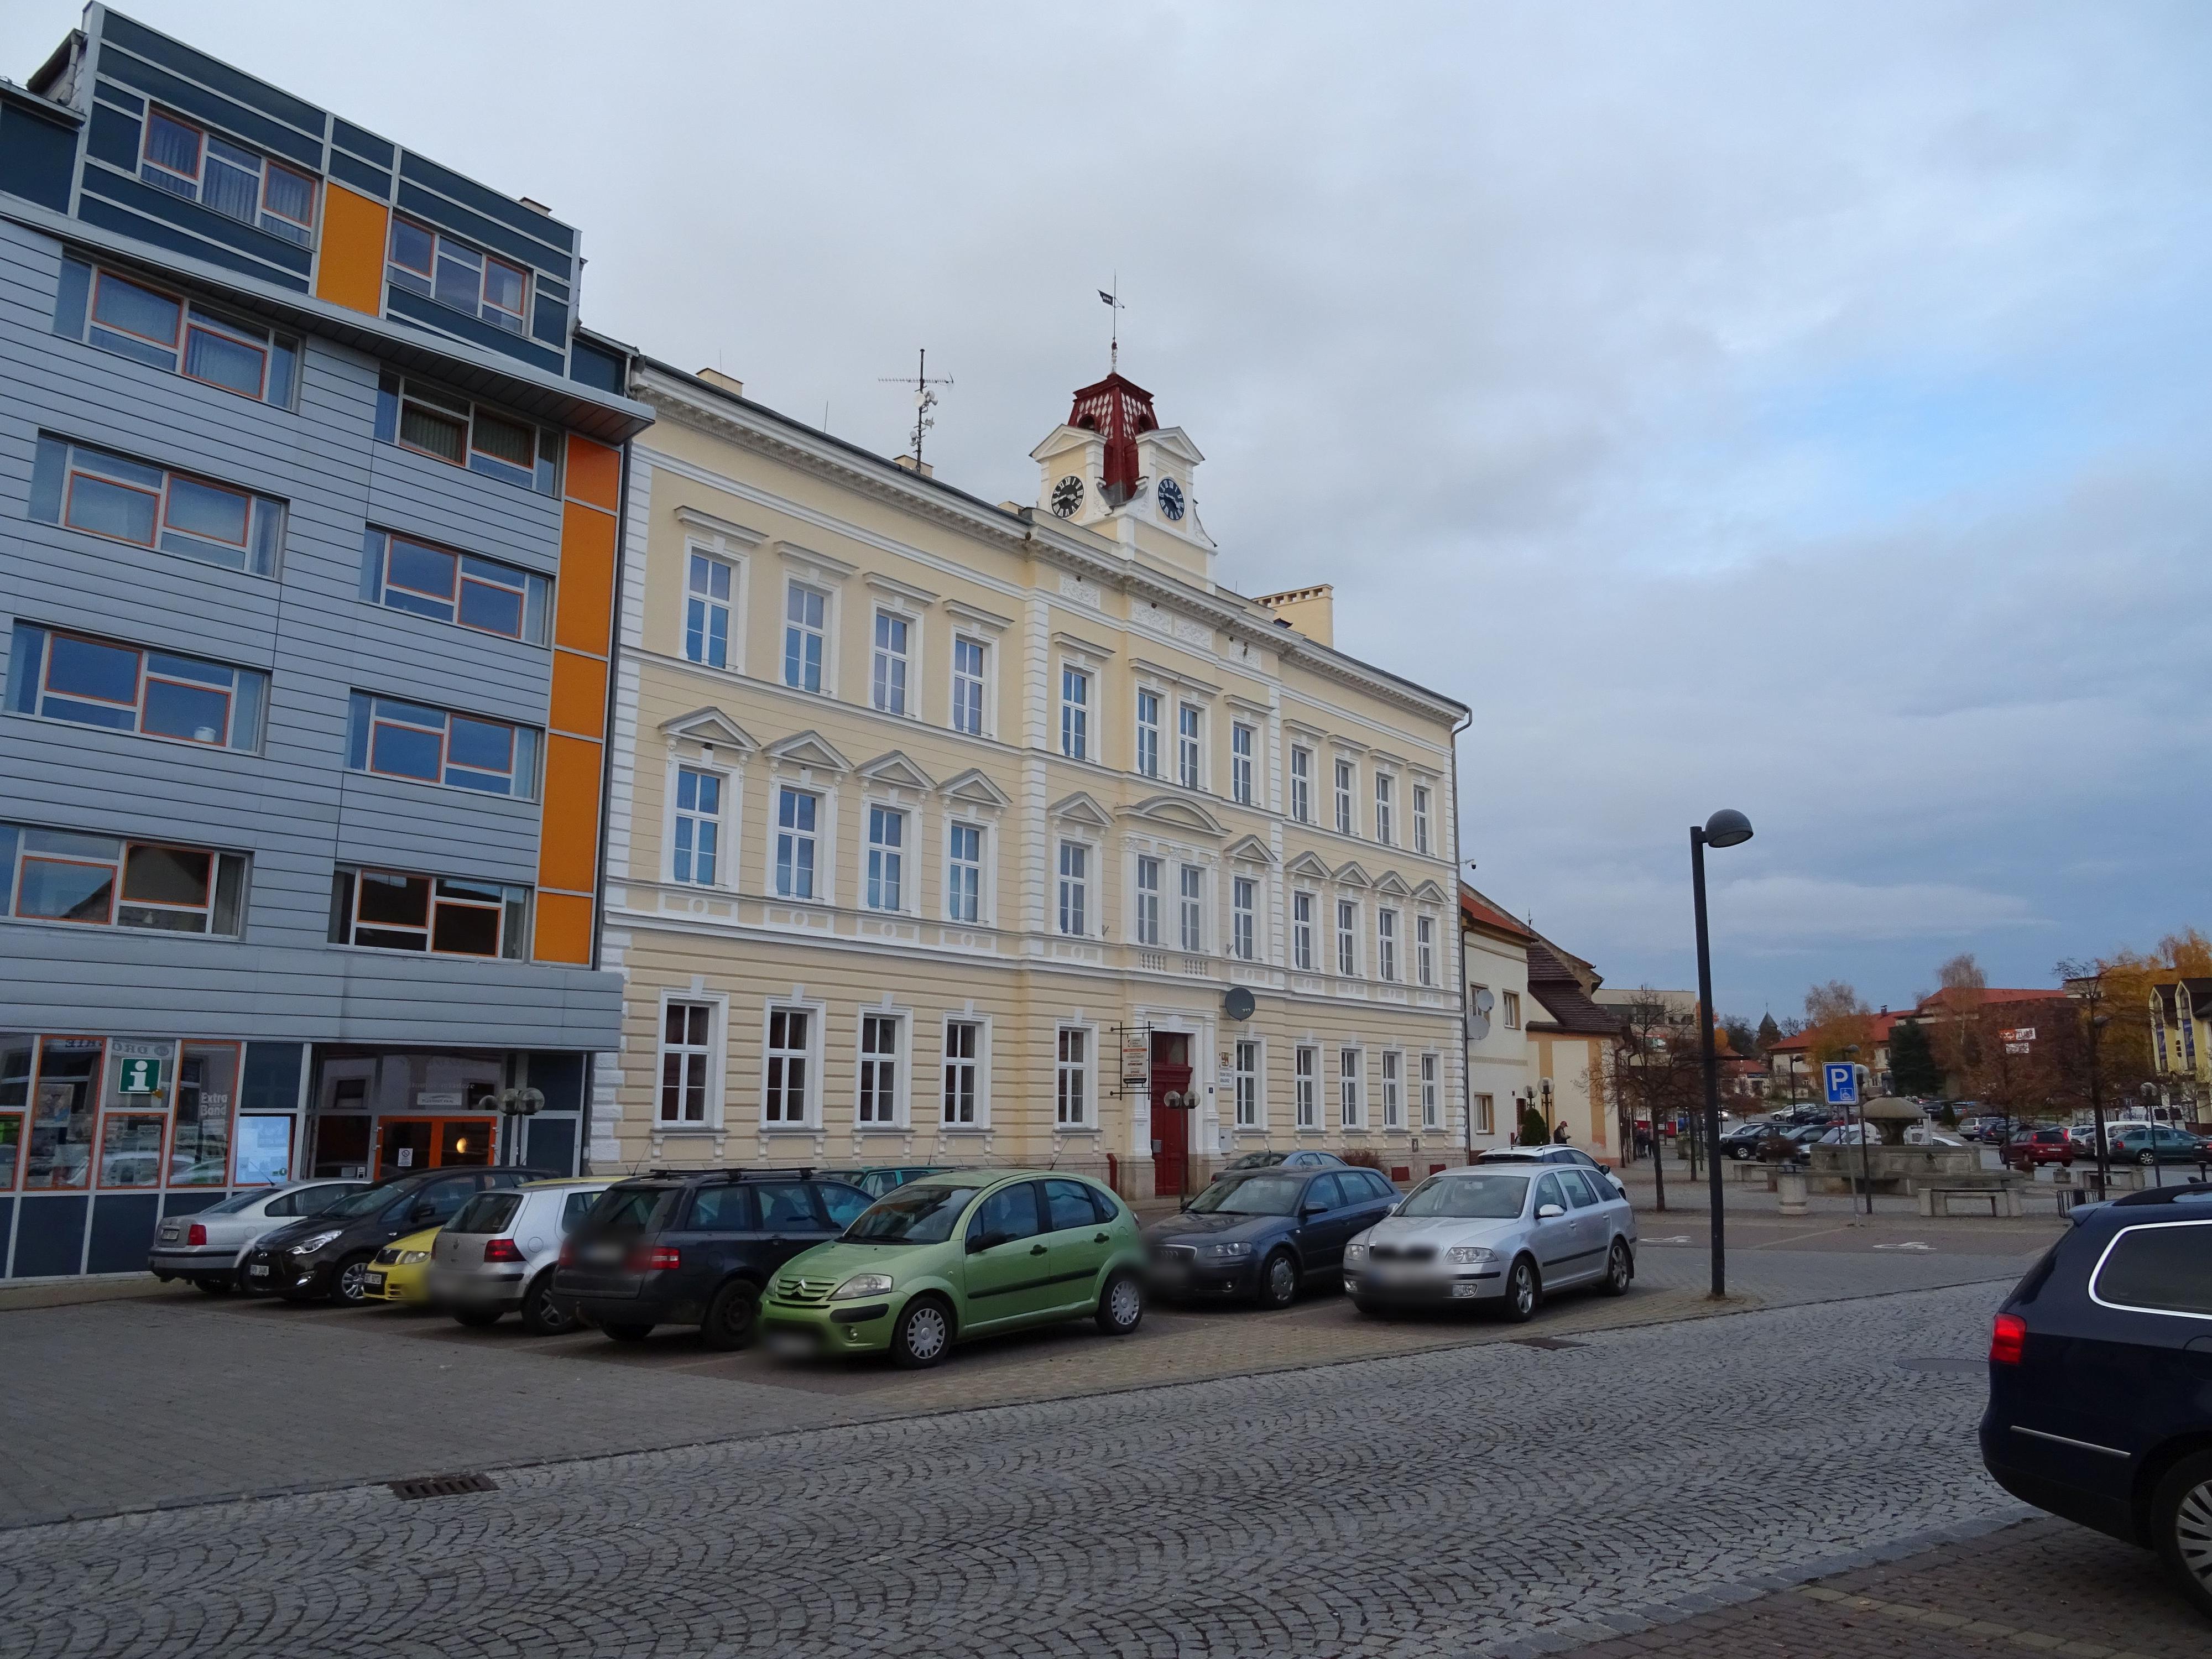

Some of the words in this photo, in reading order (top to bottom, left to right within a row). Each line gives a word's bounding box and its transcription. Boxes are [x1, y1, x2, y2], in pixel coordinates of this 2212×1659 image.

[1831, 1068, 1848, 1091] P
[201, 1092, 228, 1104] Extra
[201, 1104, 227, 1116] Band
